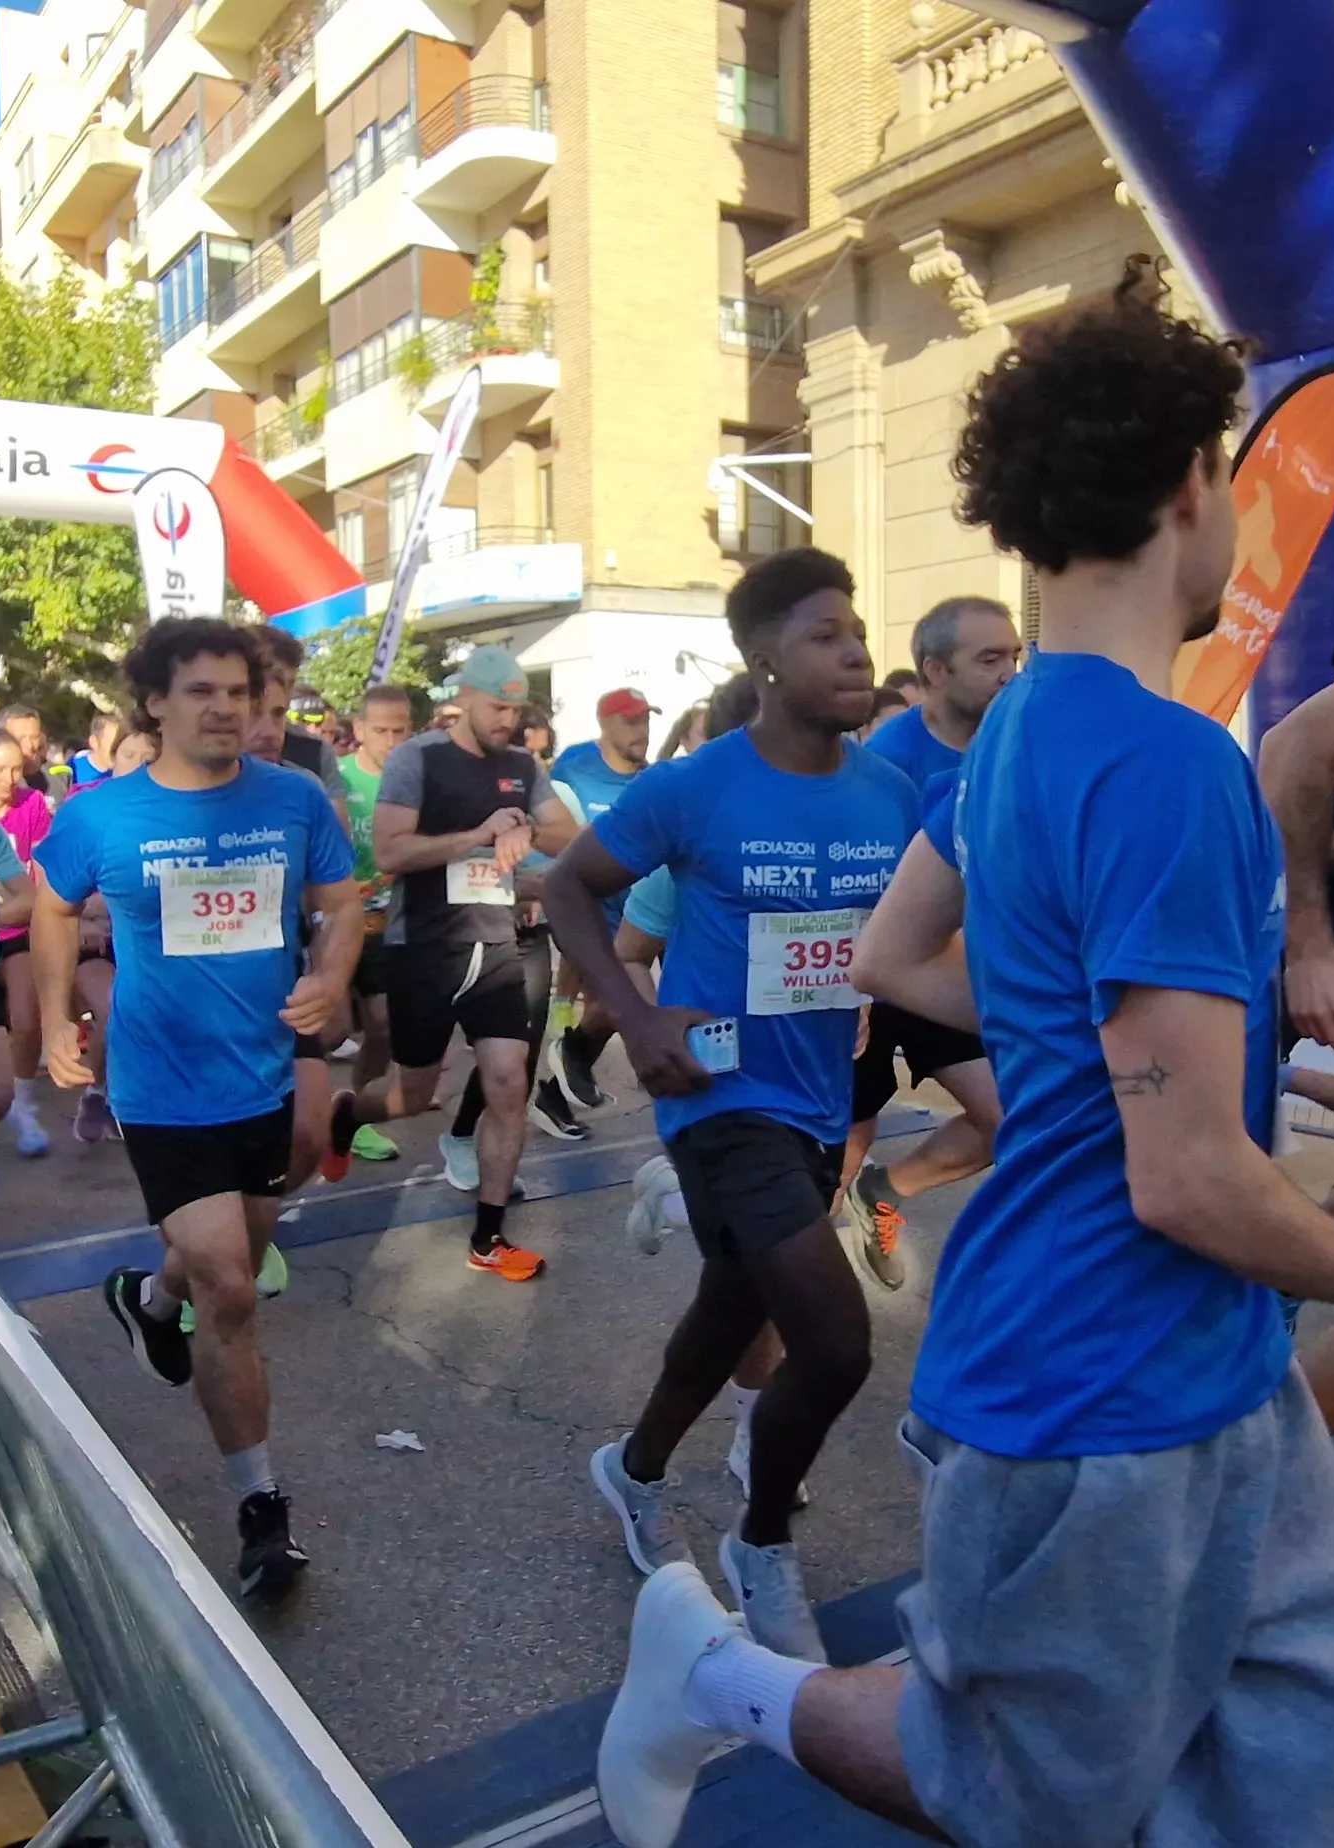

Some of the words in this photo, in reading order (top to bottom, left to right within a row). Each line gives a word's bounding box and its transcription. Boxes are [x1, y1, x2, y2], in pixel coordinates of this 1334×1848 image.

[741, 840, 816, 856] MEDIAZION
[845, 839, 896, 861] kablex
[142, 855, 209, 878] NEXT
[743, 865, 816, 887] NEXT
[193, 890, 257, 918] 393
[207, 919, 244, 932] JOSE
[783, 937, 854, 971] 395
[791, 989, 816, 1004] 8K
